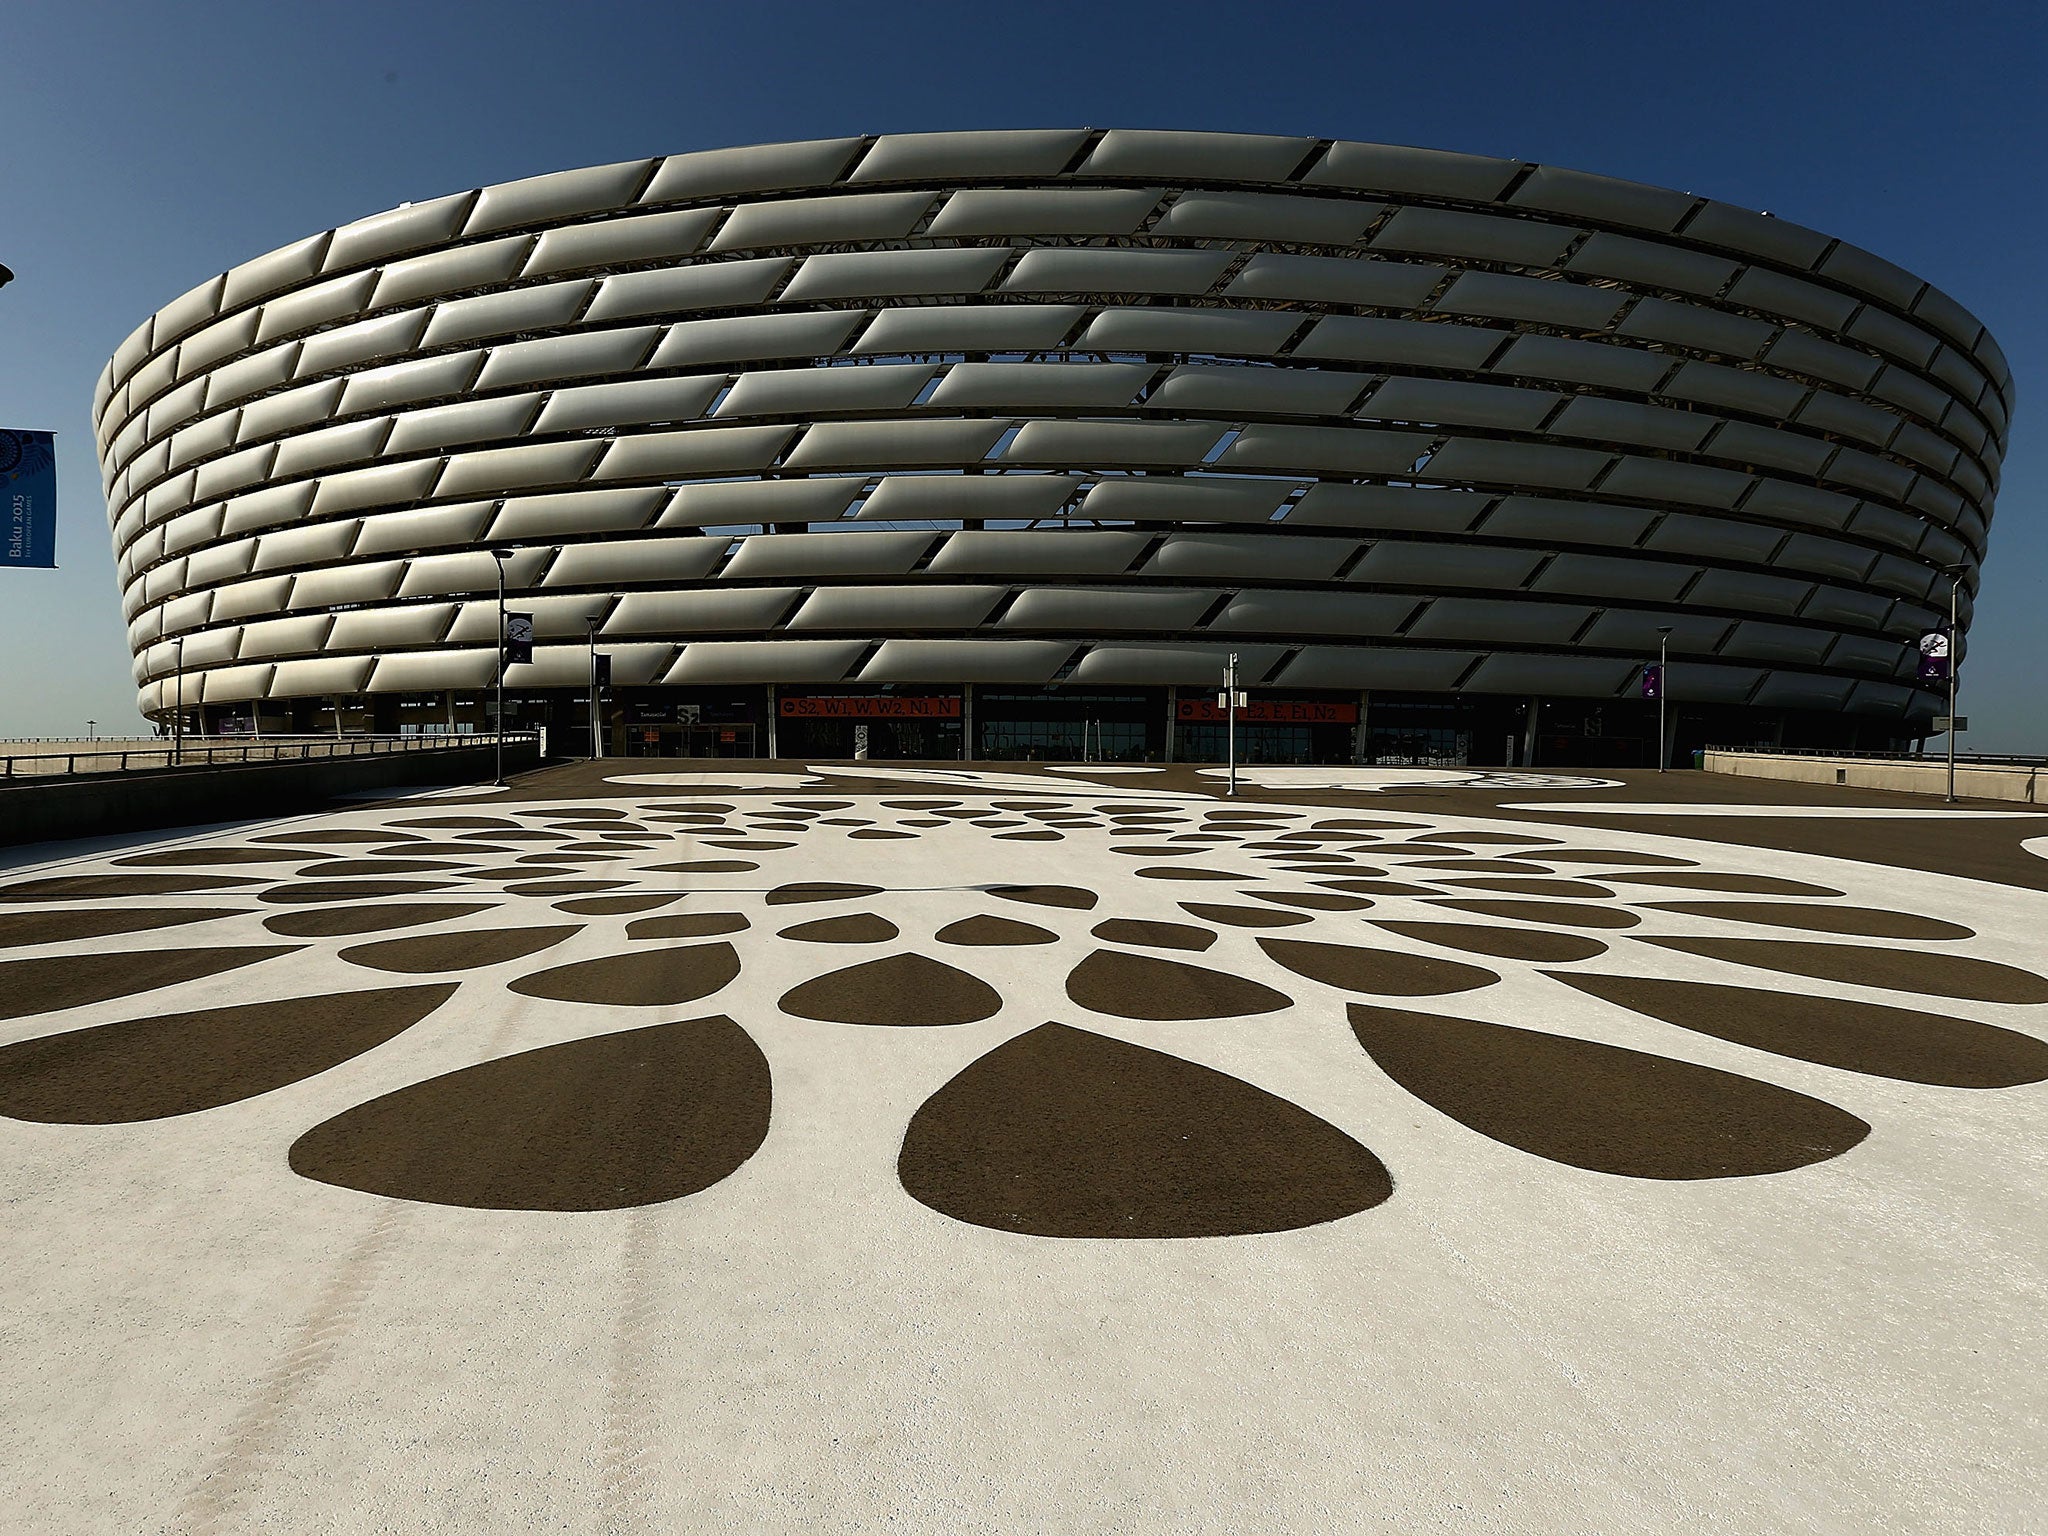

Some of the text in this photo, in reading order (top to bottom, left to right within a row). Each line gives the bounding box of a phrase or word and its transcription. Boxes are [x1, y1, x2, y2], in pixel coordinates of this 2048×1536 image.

[8, 495, 25, 557] Baku 2015
[799, 700, 820, 715] S2,
[825, 700, 851, 715] W1,
[878, 700, 905, 715] W2,
[910, 700, 933, 715] N1,
[938, 700, 952, 713] N
[1315, 706, 1337, 720] N2
[678, 708, 698, 724] S2
